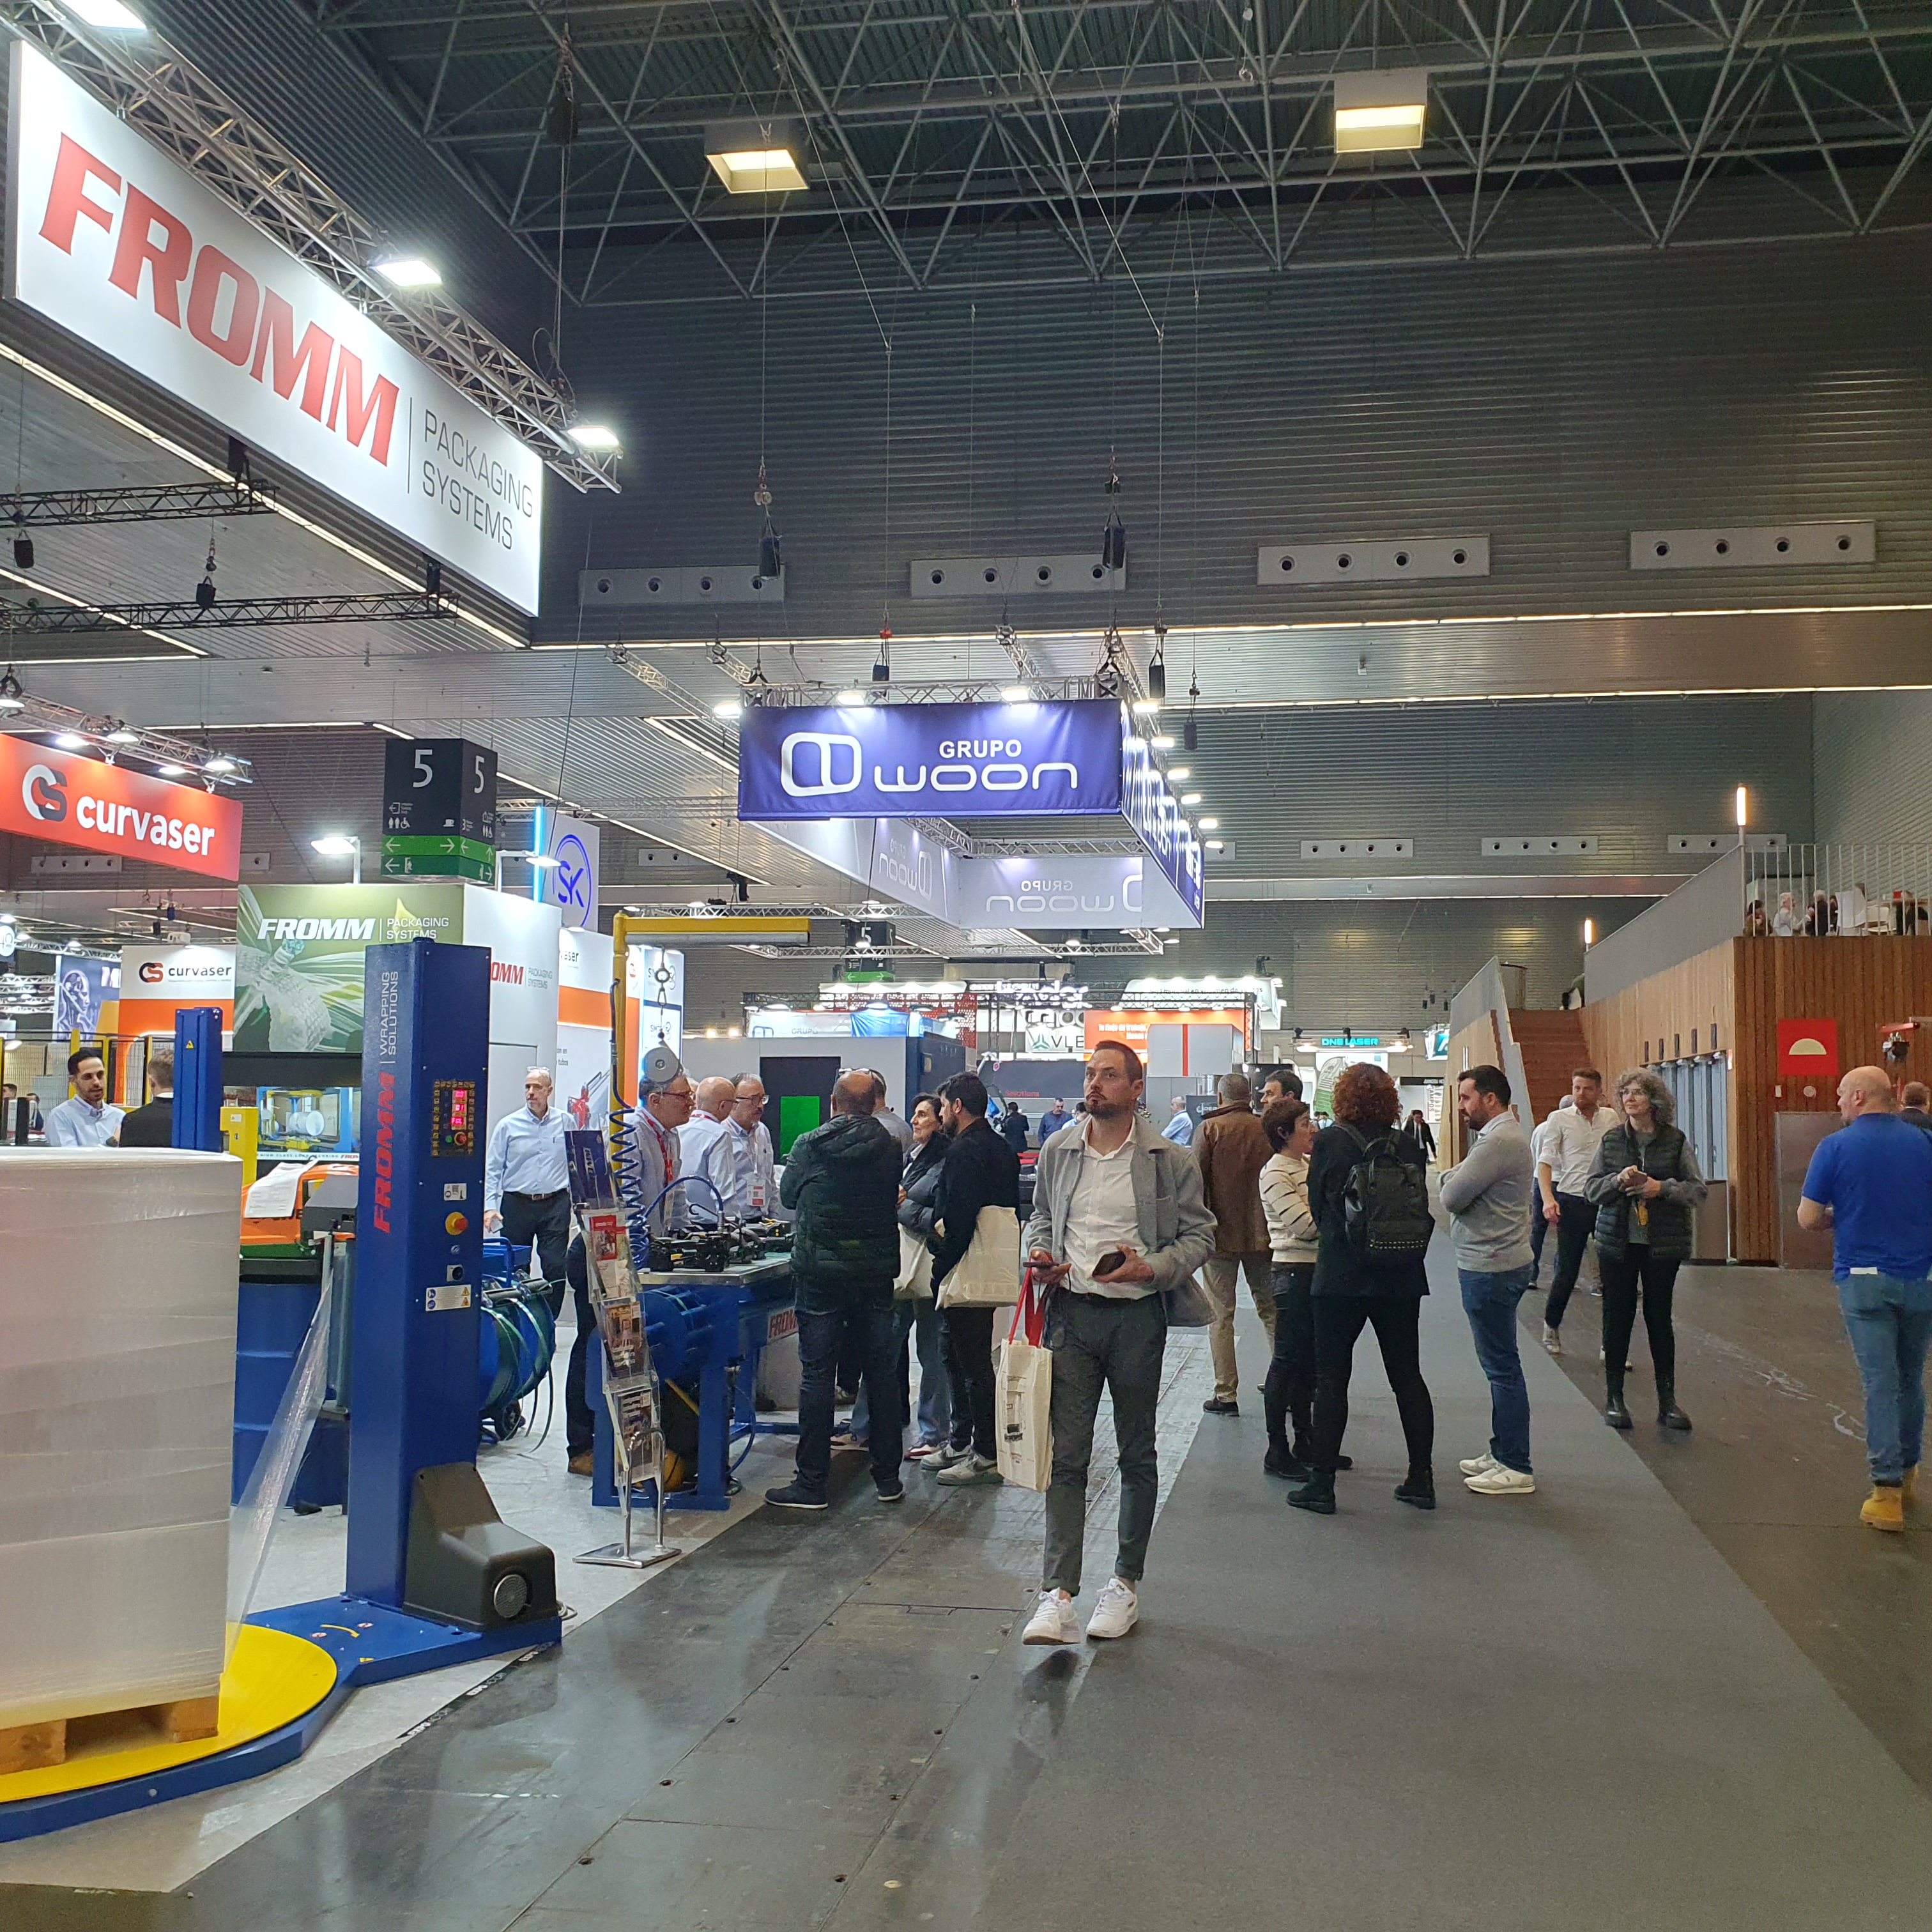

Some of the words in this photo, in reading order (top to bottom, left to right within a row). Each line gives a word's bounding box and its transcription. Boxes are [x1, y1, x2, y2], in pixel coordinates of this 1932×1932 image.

[38, 132, 399, 467] FROMM
[424, 410, 533, 519] PACKAGING
[422, 464, 514, 551] SYSTEMS
[939, 739, 1022, 759] GRUPO
[413, 749, 433, 788] 5
[474, 755, 485, 793] 5
[873, 762, 1078, 792] woon
[76, 796, 215, 856] curvaser
[257, 918, 376, 940] FROMM
[387, 917, 449, 927] PACKAGING
[386, 930, 437, 940] SYSTEMS
[168, 967, 232, 976] curvaser
[490, 962, 525, 985] OMM
[528, 967, 553, 979] PACKAGING
[527, 978, 548, 990] SYSTEMS
[379, 972, 390, 1056] WRAPPING
[388, 971, 399, 1055] SOLUTIONS
[1345, 1038, 1379, 1046] LASER
[374, 1071, 395, 1234] FROMM
